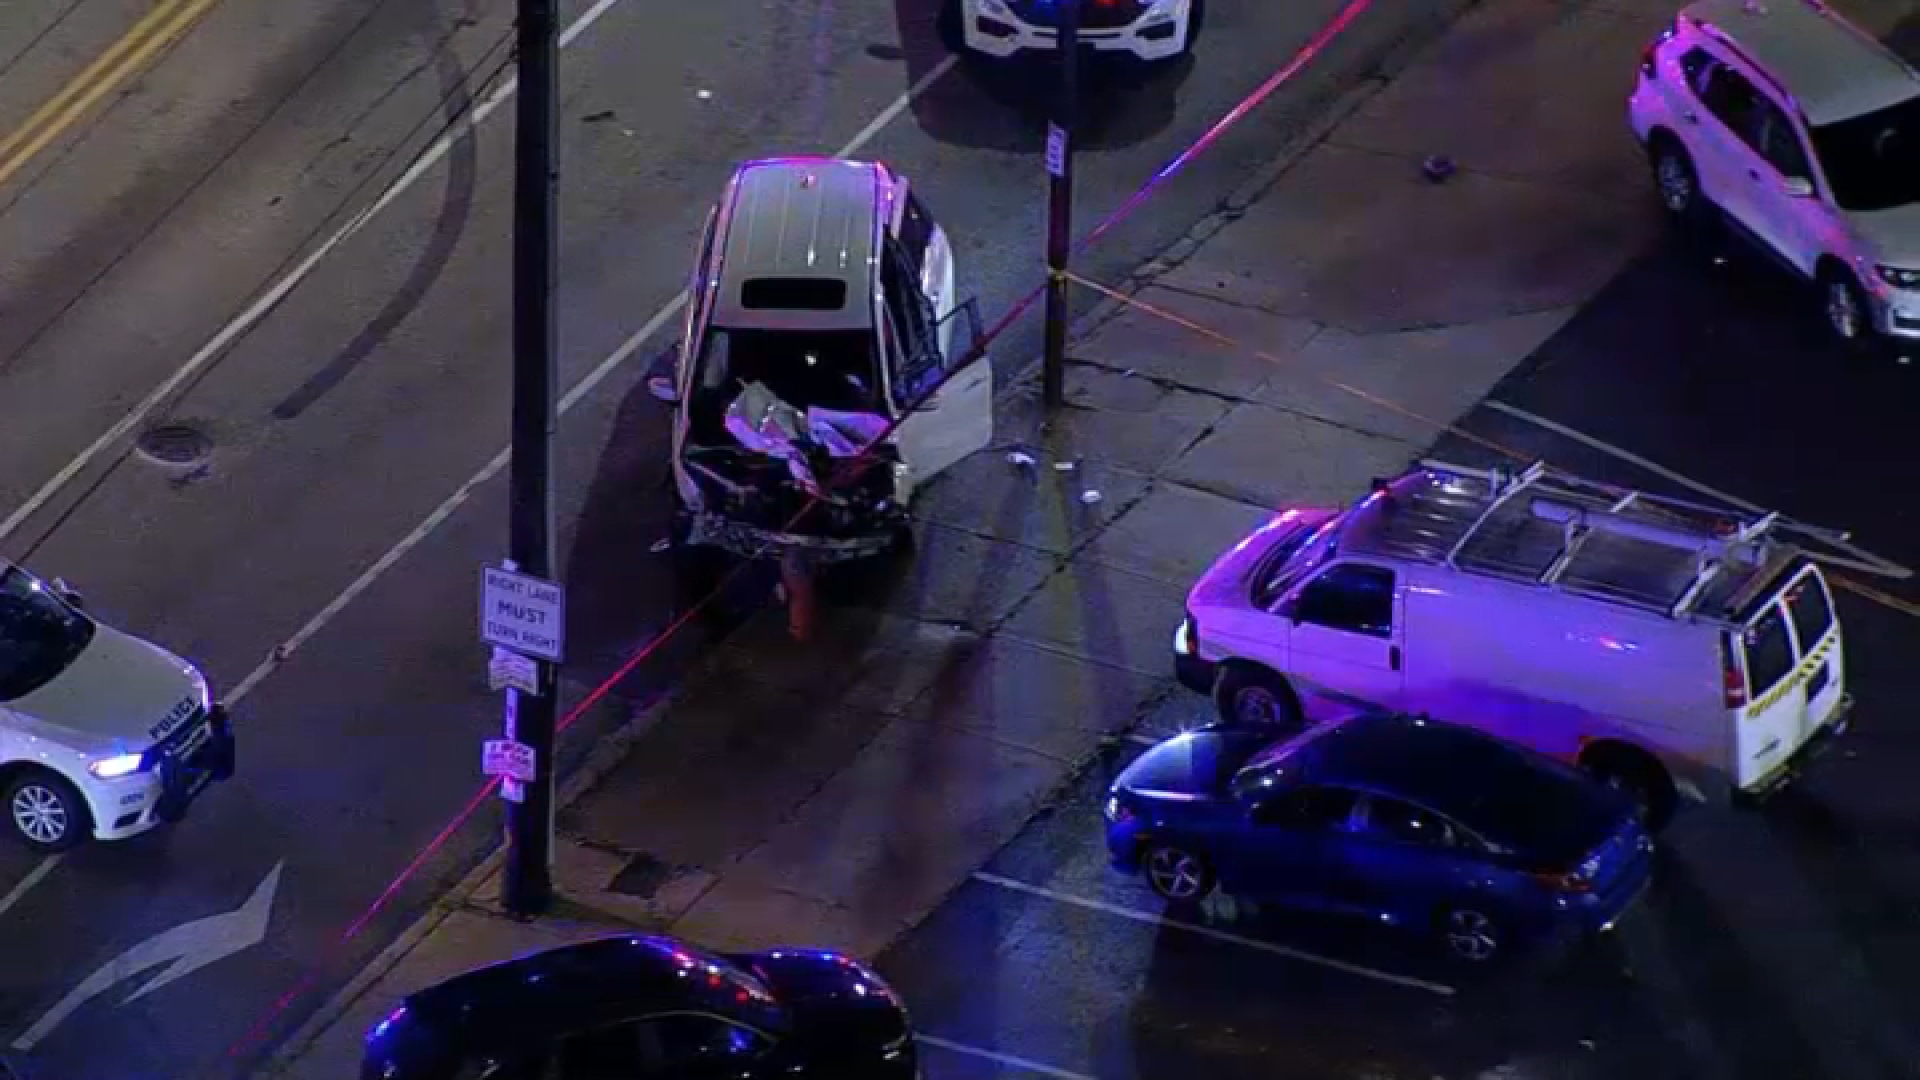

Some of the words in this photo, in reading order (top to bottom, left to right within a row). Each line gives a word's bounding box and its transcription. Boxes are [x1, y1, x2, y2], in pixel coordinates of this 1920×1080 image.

[488, 574, 522, 594] RIGHT
[527, 585, 558, 605] LANE
[498, 600, 546, 624] MUST
[487, 620, 518, 641] TURN
[522, 631, 556, 650] RIGHT
[150, 697, 195, 738] POLICE
